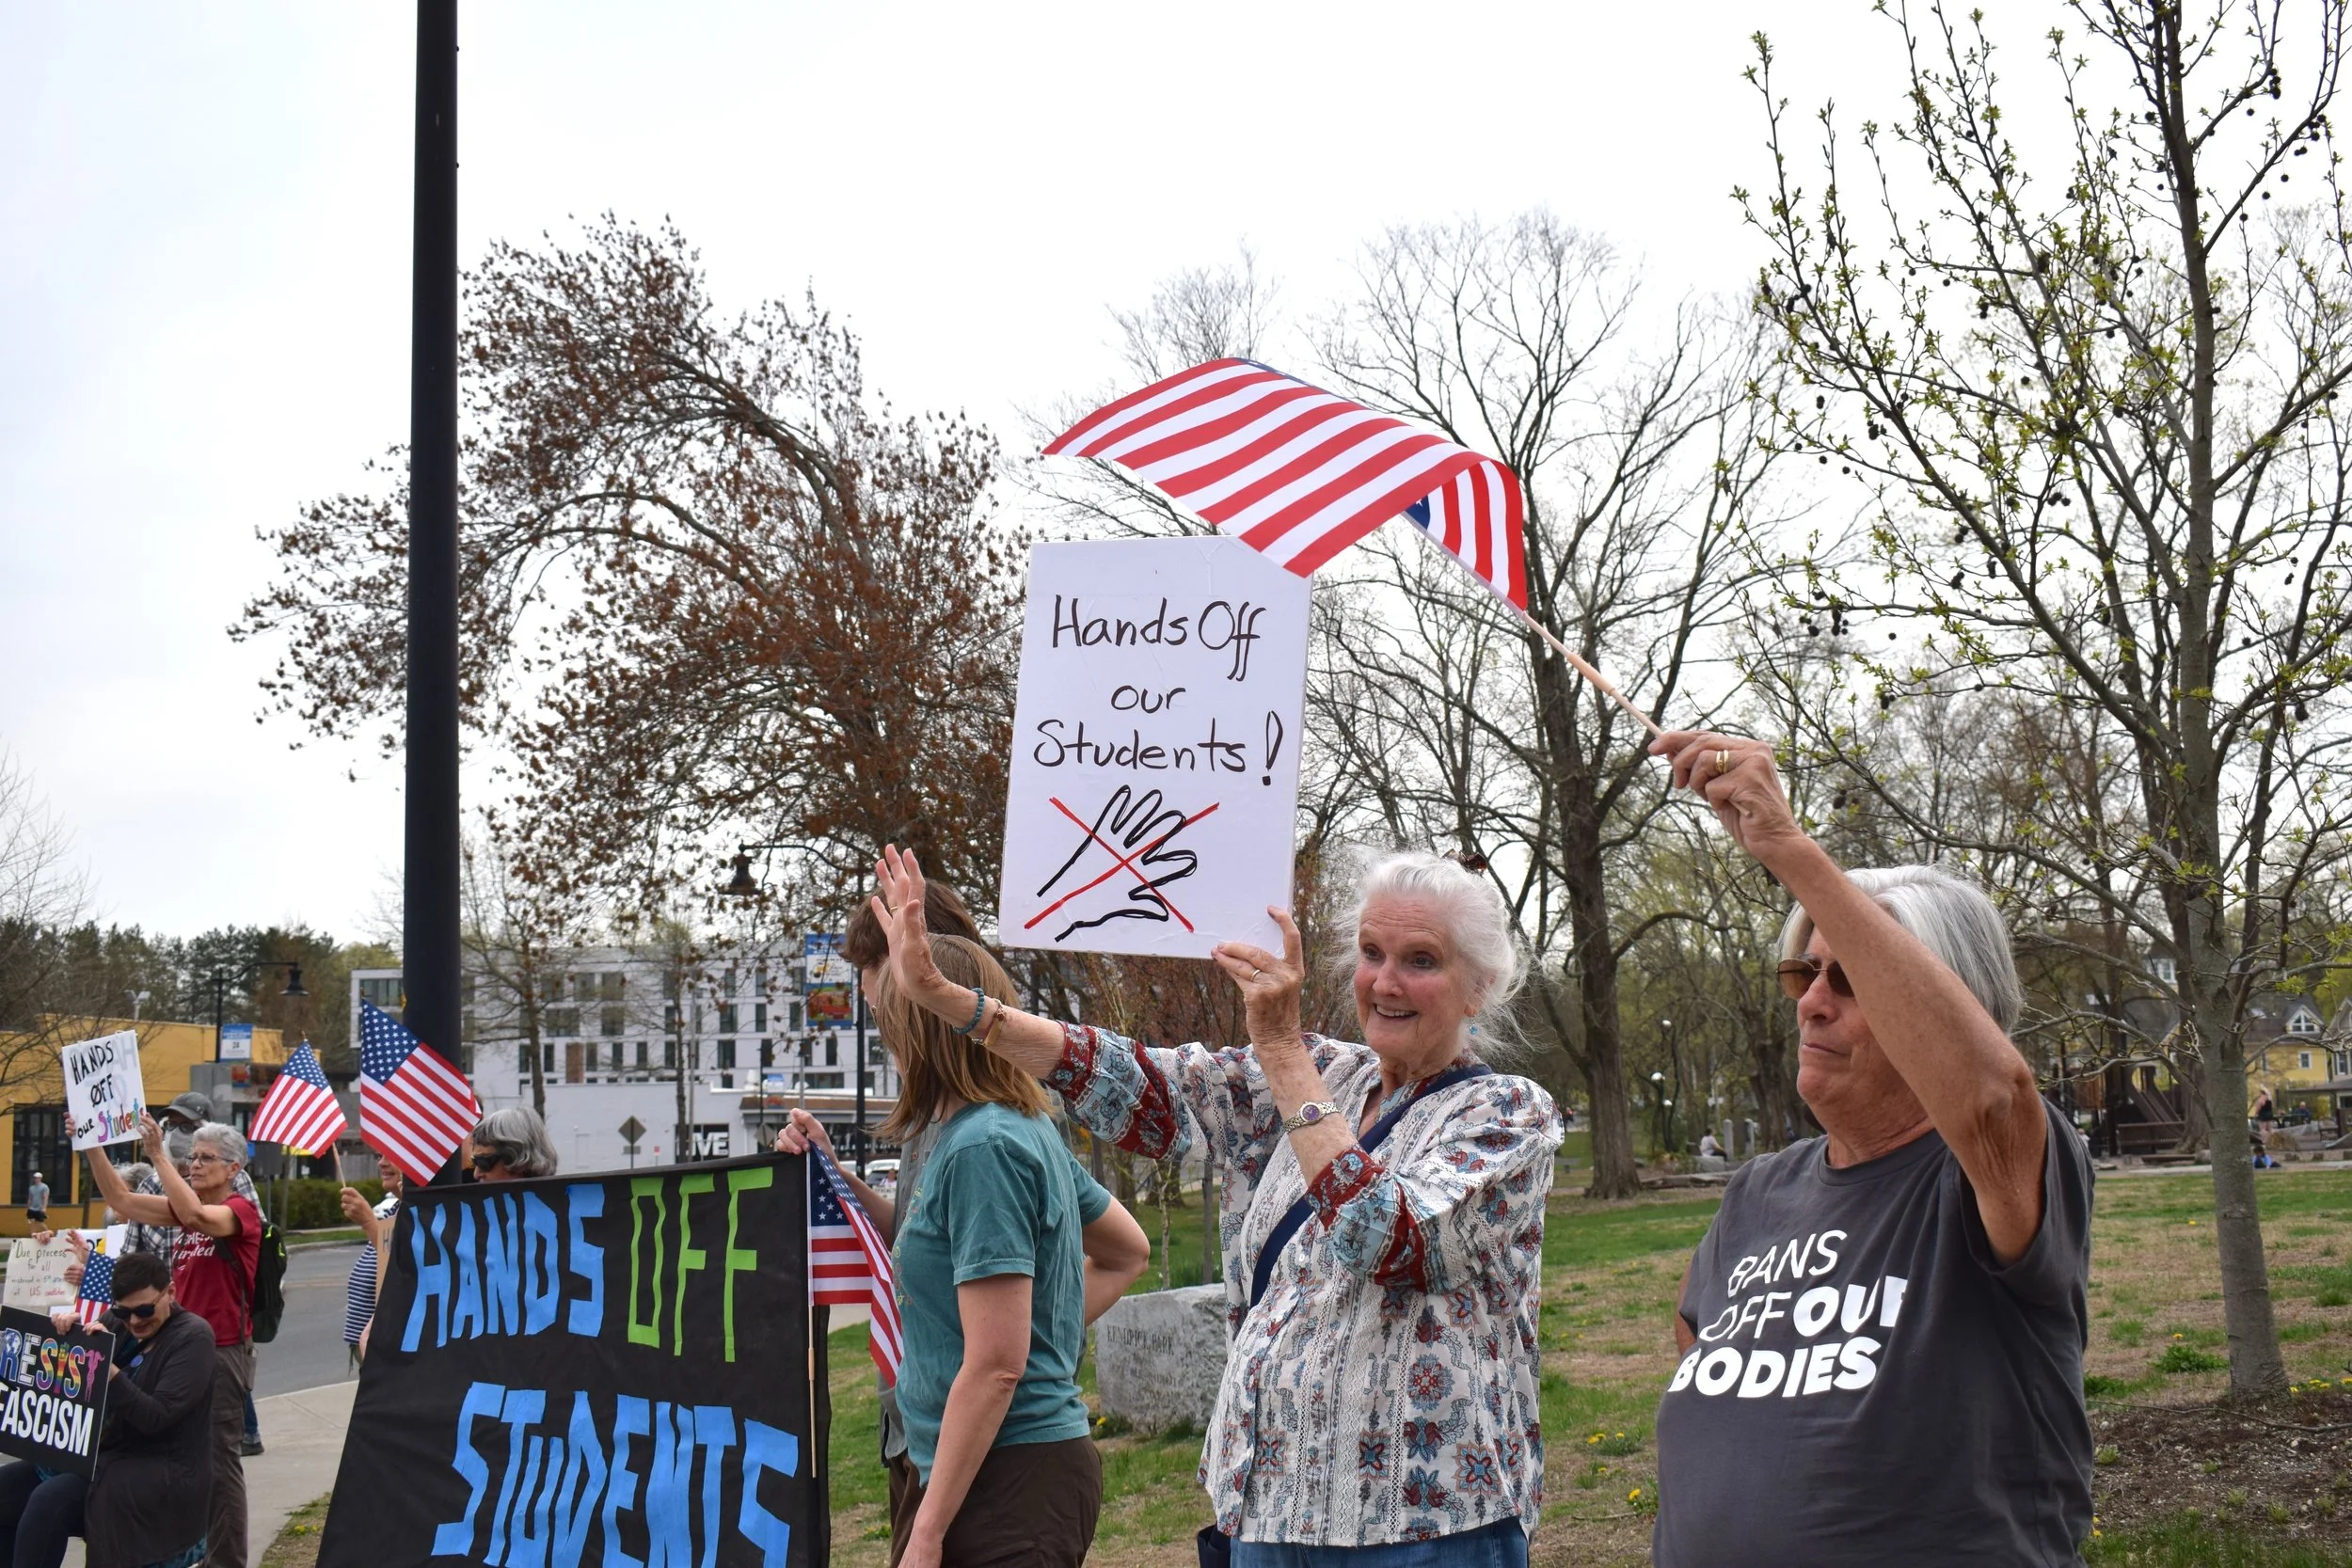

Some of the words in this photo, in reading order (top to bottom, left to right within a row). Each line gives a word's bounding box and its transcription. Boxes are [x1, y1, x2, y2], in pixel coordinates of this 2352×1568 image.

[1052, 594, 1189, 648] Hands
[1198, 600, 1267, 682] Off
[1110, 684, 1186, 714] our
[71, 1040, 114, 1085] HANDS
[400, 1182, 605, 1353] HANDS
[628, 1166, 773, 1363] OFF
[1727, 1229, 1848, 1298] BANS
[1699, 1291, 1791, 1342] OFF
[0, 1327, 105, 1402] RESIST
[1667, 1336, 1882, 1398] BODIES
[430, 1381, 799, 1568] STUDENTS
